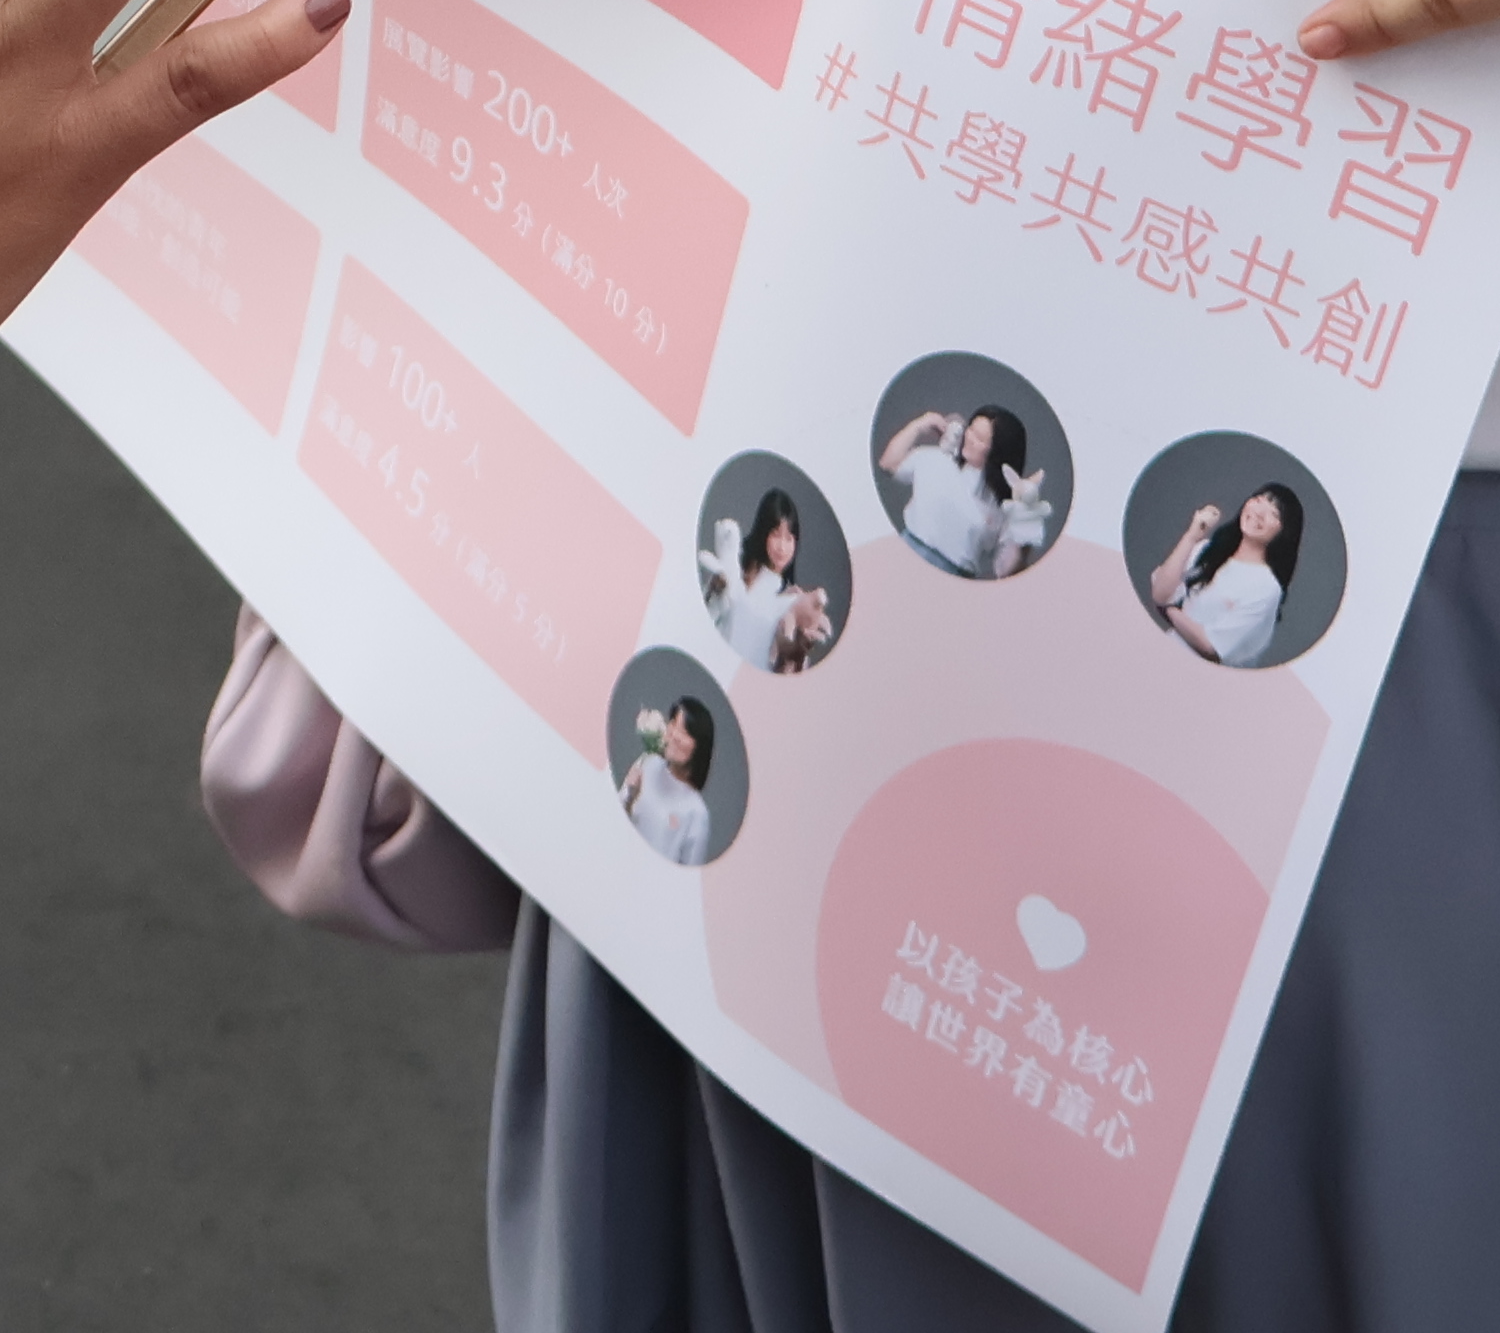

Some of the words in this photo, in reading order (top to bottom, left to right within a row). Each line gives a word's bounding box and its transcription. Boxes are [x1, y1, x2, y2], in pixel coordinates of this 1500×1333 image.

[449, 136, 507, 213] 9.3
[603, 278, 629, 319] 10
[483, 69, 575, 158] 200+
[582, 161, 631, 220] 人次
[814, 41, 1410, 390] #共學共感共創
[387, 340, 460, 434] 100+
[378, 439, 432, 519] 4.5
[880, 972, 1138, 1161] 讓世界有童心
[895, 919, 1155, 1107] 以孩子為核心
